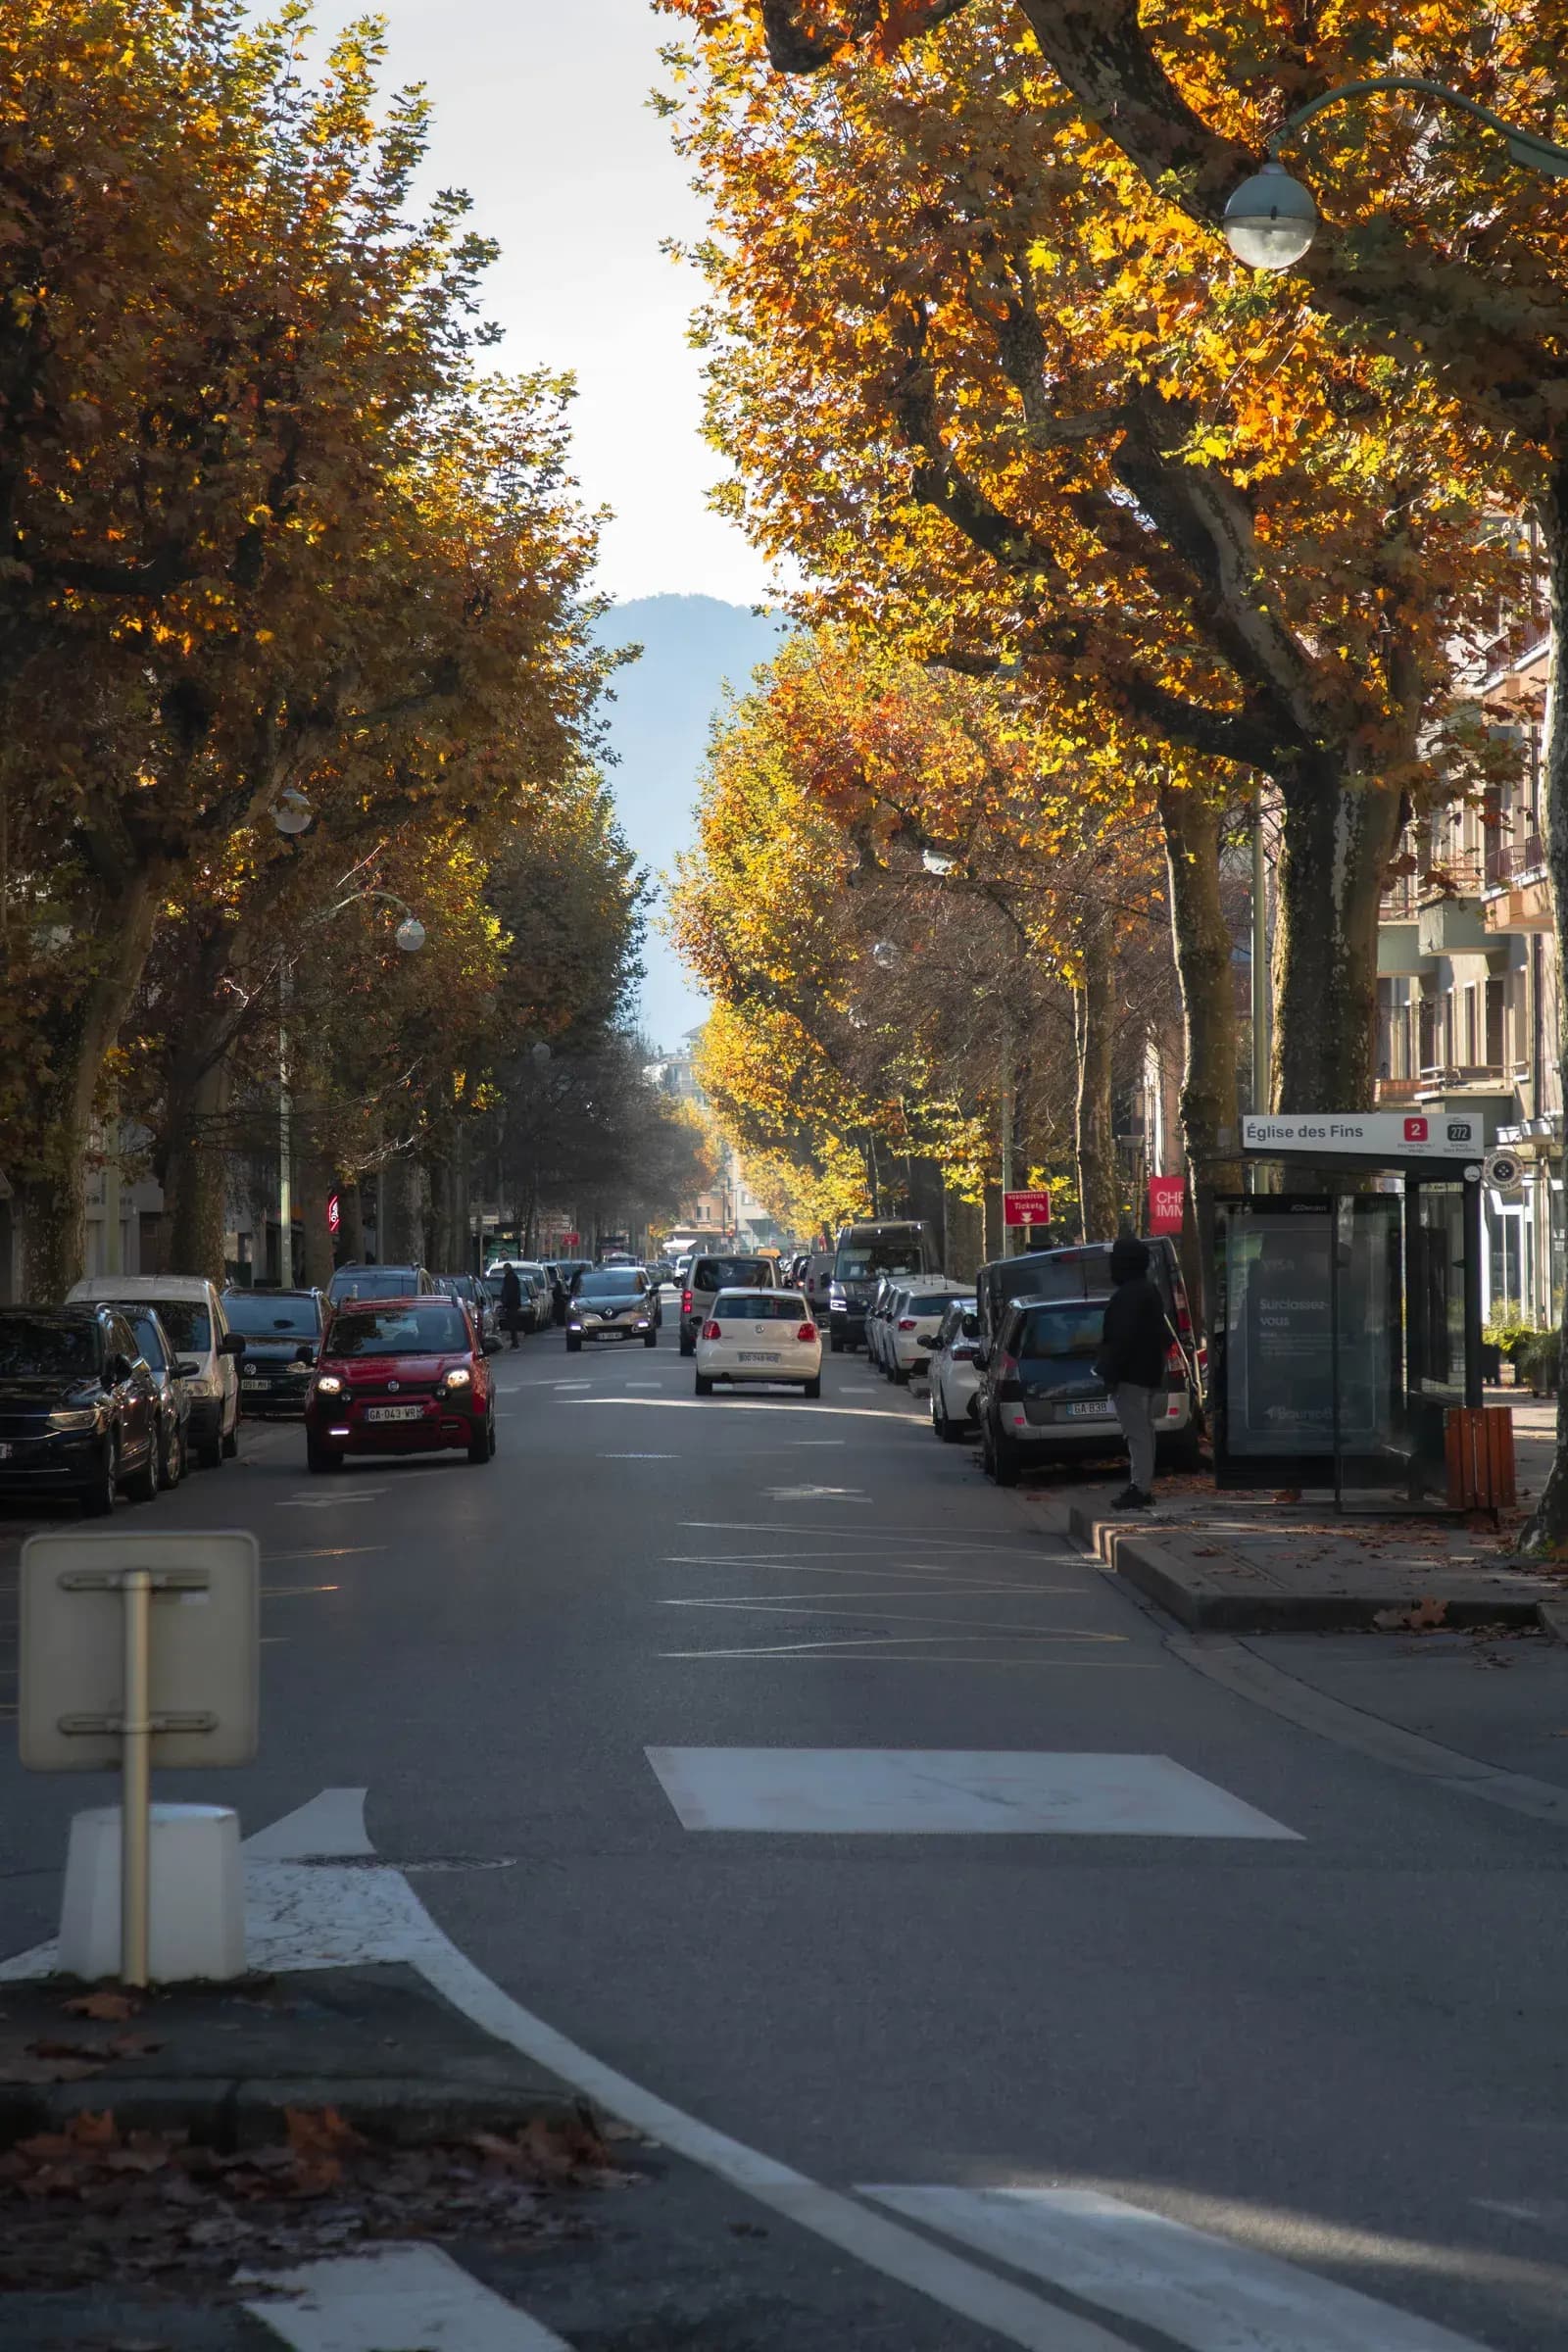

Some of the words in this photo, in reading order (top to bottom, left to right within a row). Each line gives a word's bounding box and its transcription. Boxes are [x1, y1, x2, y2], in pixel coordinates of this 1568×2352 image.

[1247, 1123, 1294, 1142] Église
[1298, 1125, 1326, 1138] des
[1330, 1124, 1363, 1138] Fins
[1411, 1123, 1421, 1136] 2
[1451, 1127, 1468, 1139] 272
[1013, 1201, 1045, 1212] Tickets
[1258, 1316, 1291, 1327] vous
